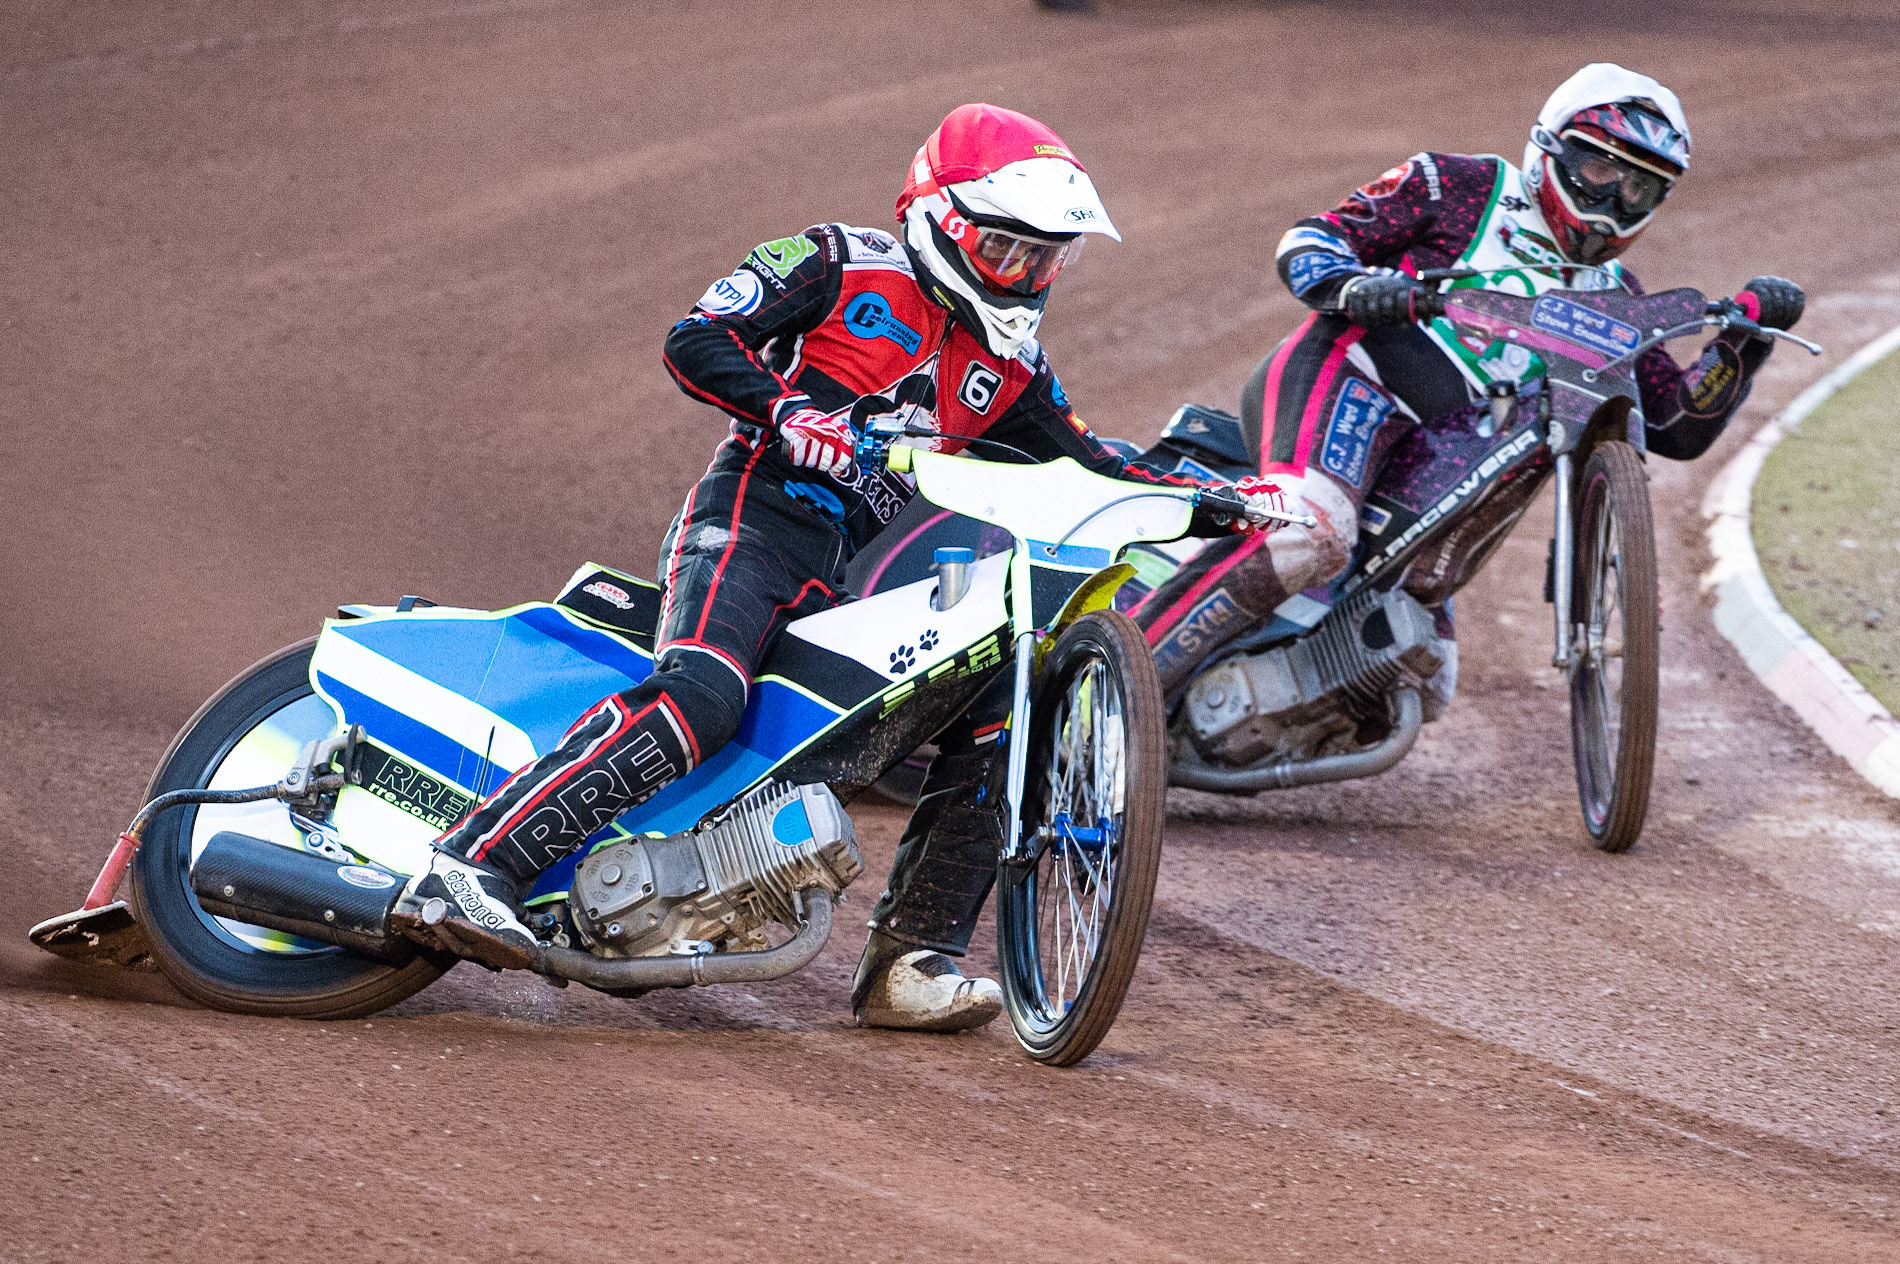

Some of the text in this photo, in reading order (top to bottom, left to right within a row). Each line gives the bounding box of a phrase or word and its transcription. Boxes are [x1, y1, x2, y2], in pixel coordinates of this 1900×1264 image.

[714, 279, 746, 306] ATPI
[965, 369, 998, 408] 6
[368, 782, 450, 832] rre.co.uk
[375, 755, 471, 822] RRE
[508, 731, 676, 870] RRE
[444, 869, 506, 929] daytona
